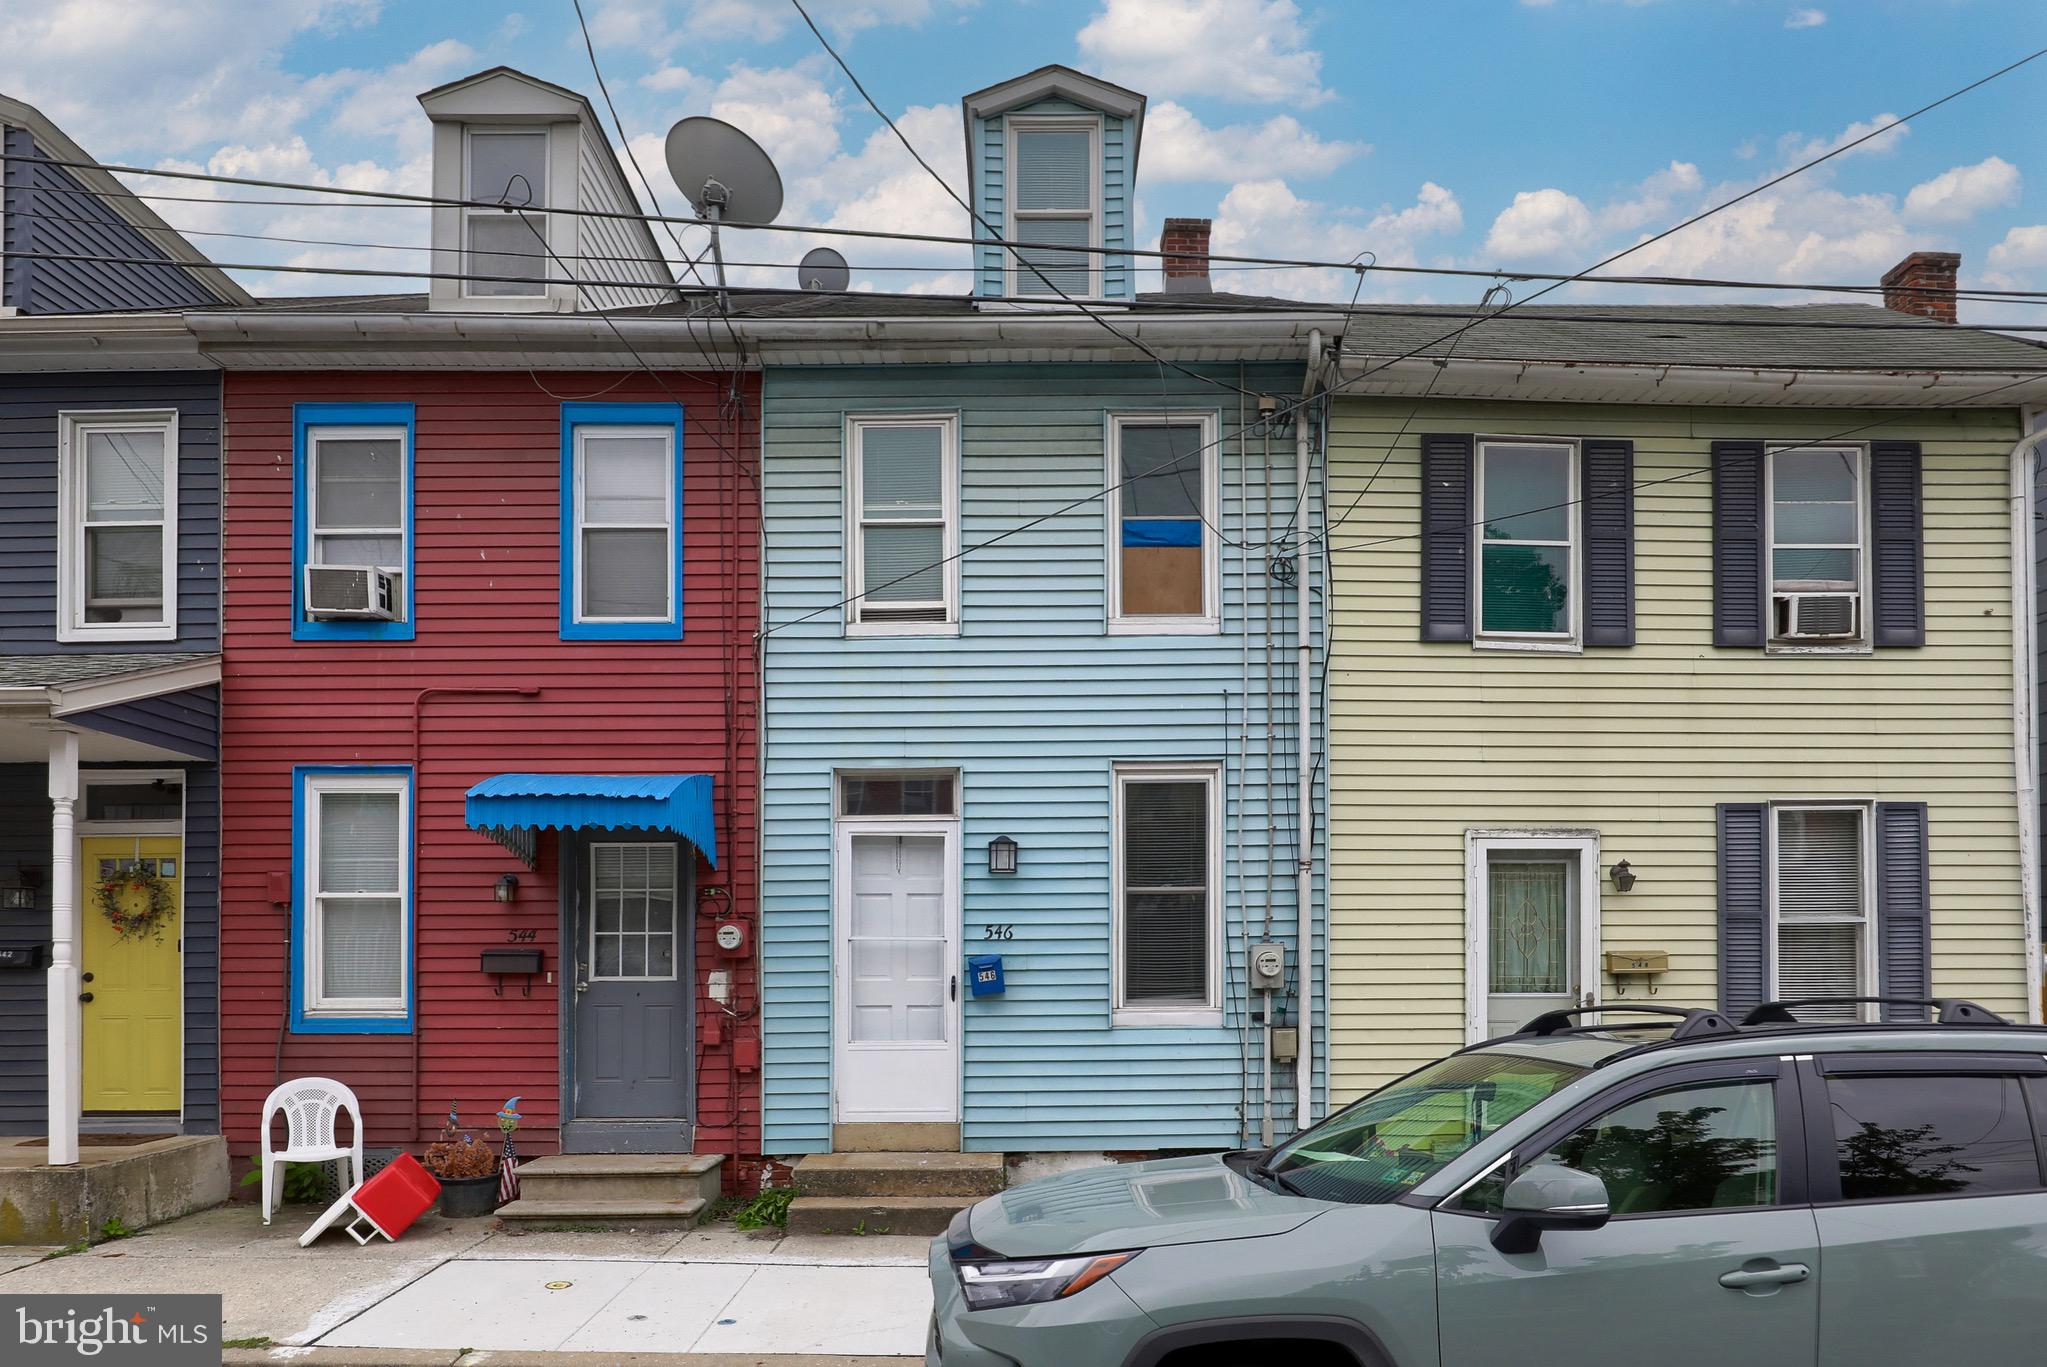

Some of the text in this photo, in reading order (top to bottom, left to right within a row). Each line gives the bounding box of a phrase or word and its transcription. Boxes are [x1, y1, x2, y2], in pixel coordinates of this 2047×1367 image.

[507, 929, 537, 943] 544
[984, 923, 1014, 940] 546
[979, 970, 995, 981] 546
